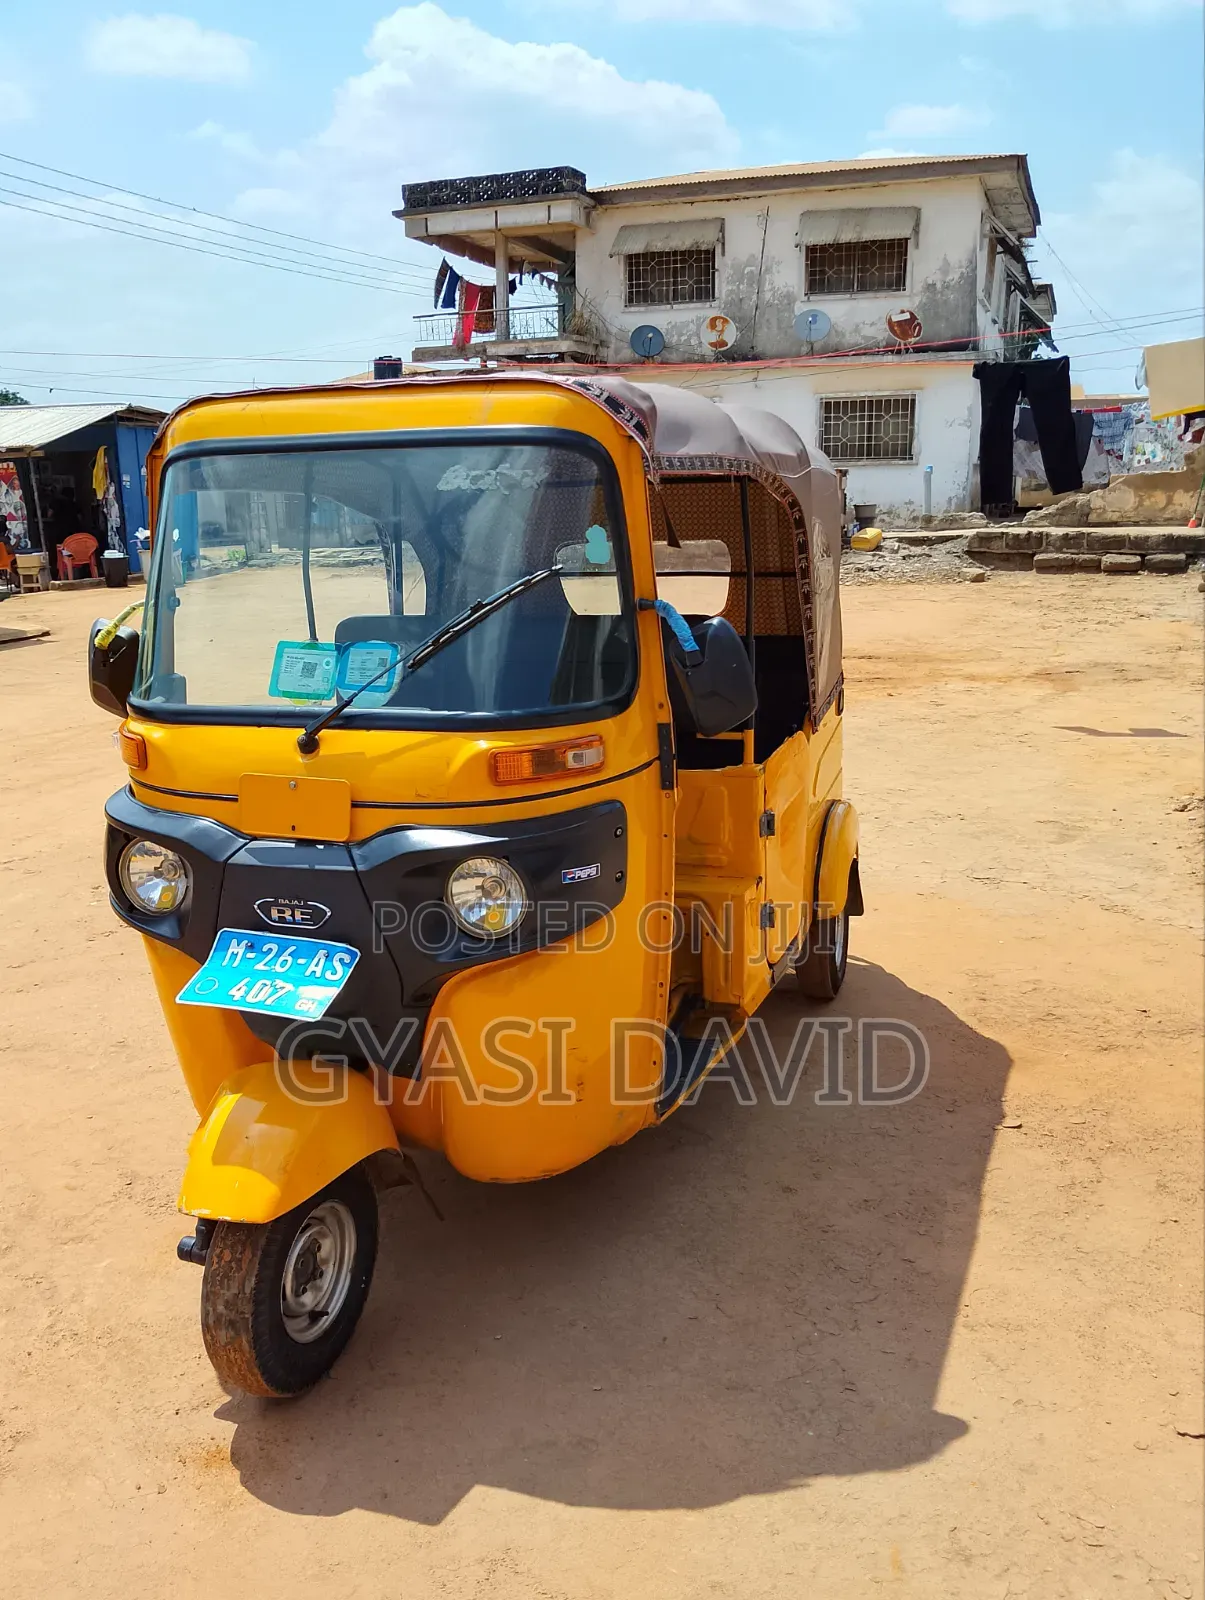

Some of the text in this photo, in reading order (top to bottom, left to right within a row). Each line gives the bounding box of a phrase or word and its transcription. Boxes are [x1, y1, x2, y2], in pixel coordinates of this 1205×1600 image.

[575, 867, 597, 879] PEPSI
[278, 898, 304, 906] BAJAJ
[271, 906, 314, 924] RE
[221, 938, 352, 982] M-26-AS
[227, 977, 296, 1006] 407
